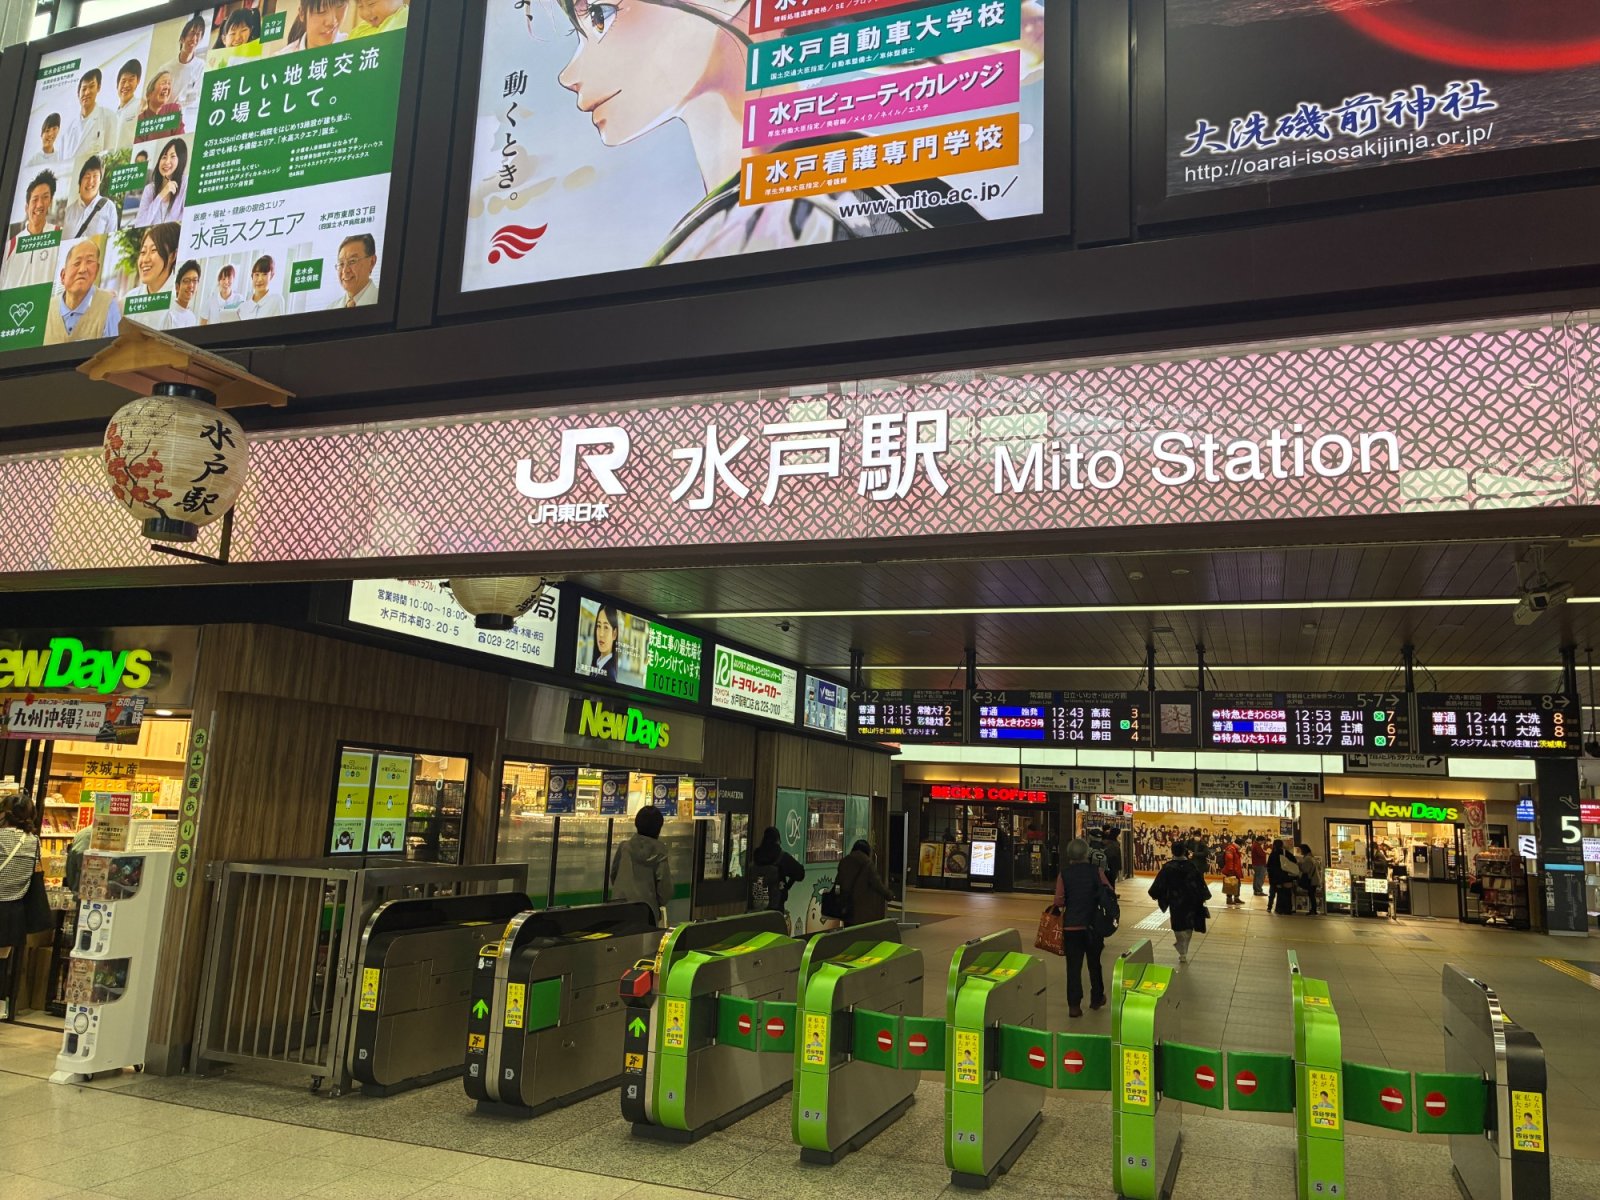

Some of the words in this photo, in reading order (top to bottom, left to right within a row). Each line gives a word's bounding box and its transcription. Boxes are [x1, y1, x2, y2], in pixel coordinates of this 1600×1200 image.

[770, 1, 1006, 69] 水戸自動車大学校
[211, 46, 380, 102] 新しい地域交流
[768, 61, 1004, 126] 水戸ビューティカレッジ
[208, 87, 337, 126] の場として。
[1180, 80, 1498, 157] 大洗磯前神社
[498, 69, 528, 201] 動くとき。
[765, 123, 1003, 185] 水戸看護専門学校
[1184, 122, 1494, 183] http://oarai-isosakijinja.or.jp/
[110, 181, 129, 191] カレッジ
[319, 205, 376, 222] 水戸市東原3丁目
[189, 212, 306, 250] 水高スクエア
[173, 419, 236, 516] 水戸駅
[515, 426, 630, 499] JR
[669, 409, 950, 511] 水戸駅
[993, 441, 1125, 494] Mito
[1151, 423, 1400, 486] Station
[528, 503, 610, 524] JR東日本
[377, 588, 408, 606] 営業時間
[652, 672, 695, 697] TOTETSU
[731, 675, 782, 699] トヨタレンタカー
[858, 704, 876, 715] 普通
[882, 704, 912, 715] 13:15
[944, 705, 952, 716] 2
[1541, 694, 1554, 710] 8
[13, 707, 77, 730] 九州沖縄
[858, 715, 876, 726] 普通
[882, 715, 912, 726] 14:15
[944, 716, 952, 727] 2
[979, 706, 999, 717] 普通
[1020, 707, 1038, 717] 始発
[1052, 707, 1084, 718] 12:43
[1090, 707, 1111, 718] 高萩
[1131, 708, 1139, 719] 3
[1220, 709, 1286, 721] 特急ときわ68号
[1295, 709, 1332, 721] 12:53
[1340, 710, 1364, 722] 品川
[1386, 711, 1394, 722] 7
[1432, 711, 1457, 723] 普通
[1466, 711, 1508, 724] 12:44
[1515, 712, 1541, 724] 大洗
[1553, 712, 1564, 725] 8
[578, 698, 670, 750] NewDays
[987, 717, 1044, 728] 特急ときわ59号
[1052, 718, 1084, 729] 12:47
[1090, 719, 1112, 730] 勝田
[1131, 720, 1139, 730] 4
[1212, 721, 1234, 732] 普通
[1295, 721, 1332, 733] 13:04
[1340, 722, 1364, 734] 土浦
[1387, 723, 1396, 734] 6
[1432, 724, 1457, 736] 普通
[1466, 724, 1507, 737] 13:11
[1516, 725, 1542, 737] 大洗
[1554, 726, 1565, 738] 8
[979, 728, 999, 739] 普通
[1052, 729, 1084, 740] 13:04
[1090, 730, 1112, 741] 勝田
[1131, 731, 1139, 742] 4
[1221, 733, 1287, 745] 特急ひたち14号
[1295, 734, 1333, 746] 13:27
[1340, 735, 1365, 747] 品川
[1387, 735, 1396, 747] 7
[85, 760, 139, 776] 茨城土産
[988, 789, 1048, 803] COFFEE
[175, 732, 205, 883] お土産あります
[1369, 801, 1458, 822] NewDays
[1561, 815, 1581, 844] 5
[506, 1070, 512, 1079] 9
[630, 1087, 637, 1096] 9
[804, 1110, 810, 1119] 8
[815, 1112, 821, 1121] 7
[957, 1133, 964, 1141] 7
[970, 1134, 976, 1143] 6
[1127, 1156, 1135, 1166] 6
[1141, 1158, 1148, 1168] 5
[1315, 1182, 1323, 1192] 5
[1330, 1184, 1338, 1195] 4
